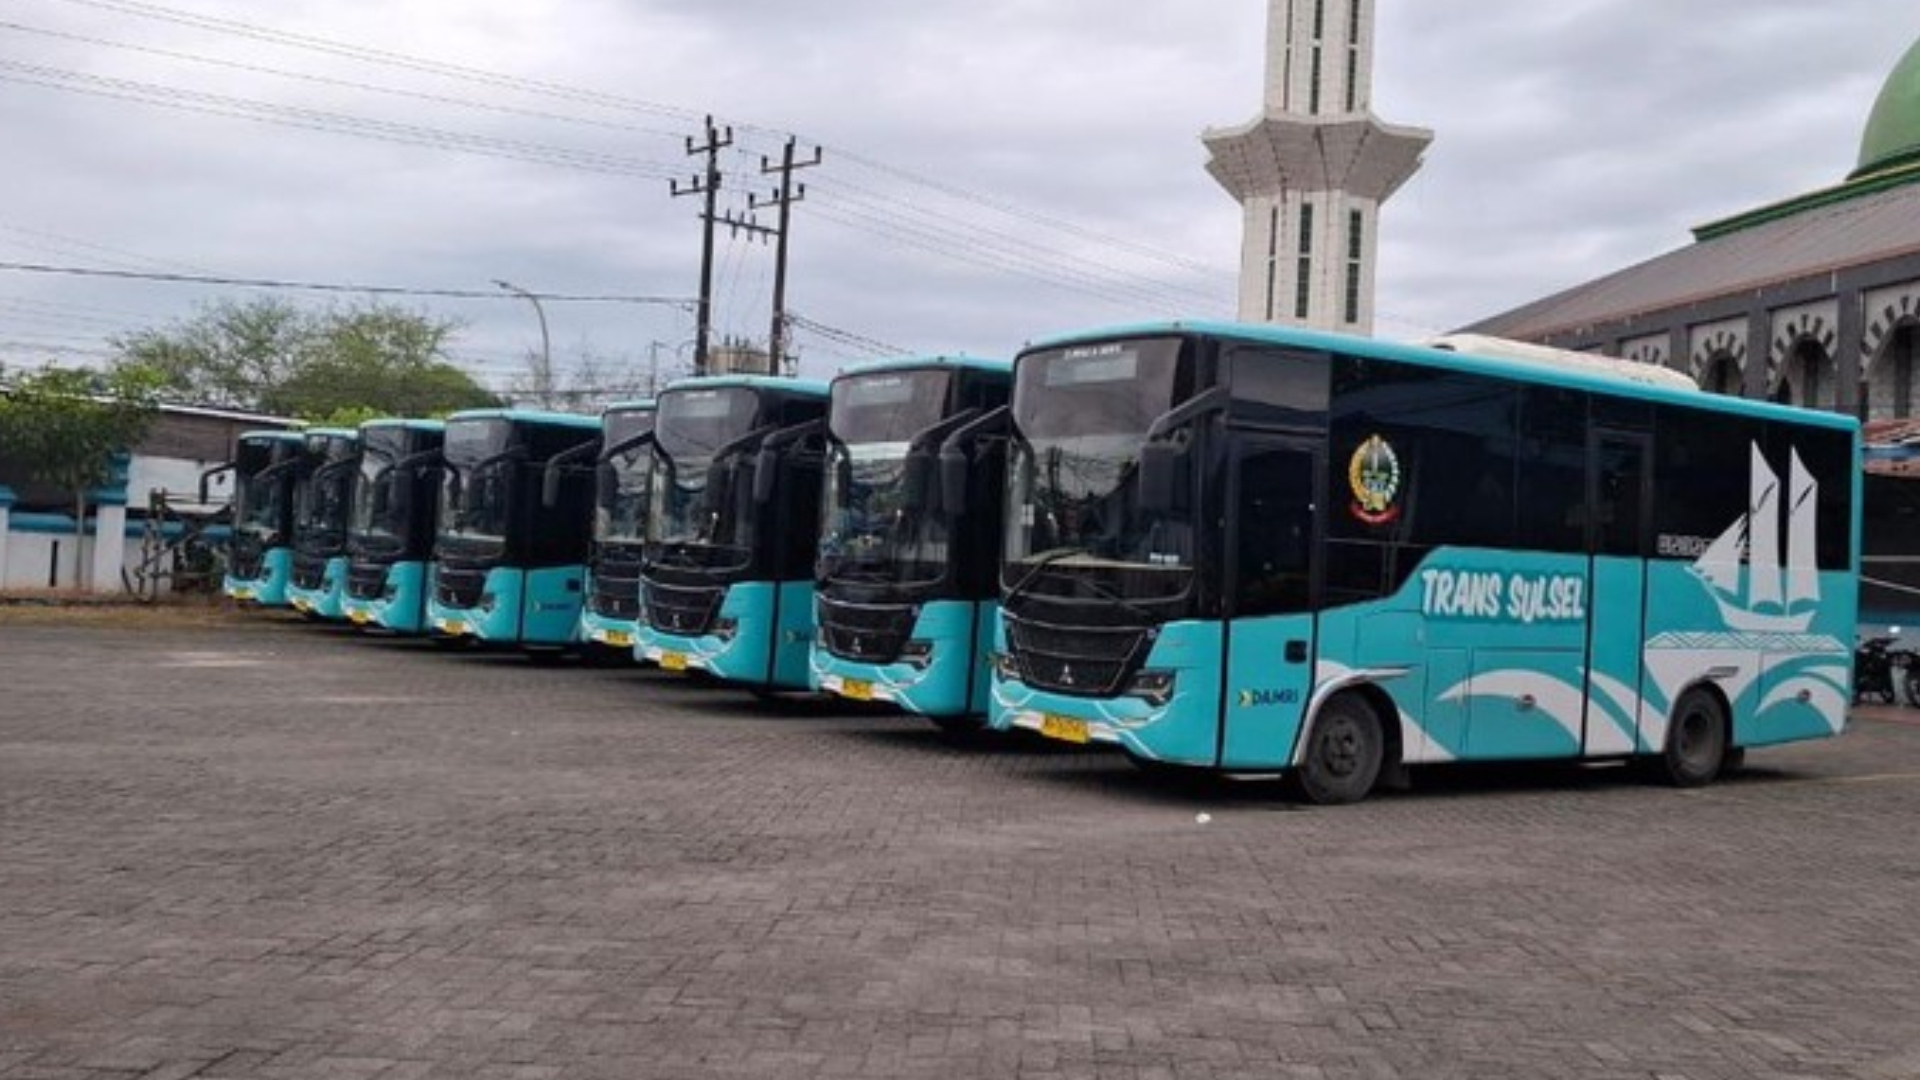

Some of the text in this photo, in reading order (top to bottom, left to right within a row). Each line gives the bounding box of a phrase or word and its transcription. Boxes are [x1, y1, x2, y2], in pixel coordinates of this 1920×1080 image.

[1421, 569, 1584, 623] TRANS SULSEL
[1251, 688, 1299, 707] DAMRI
